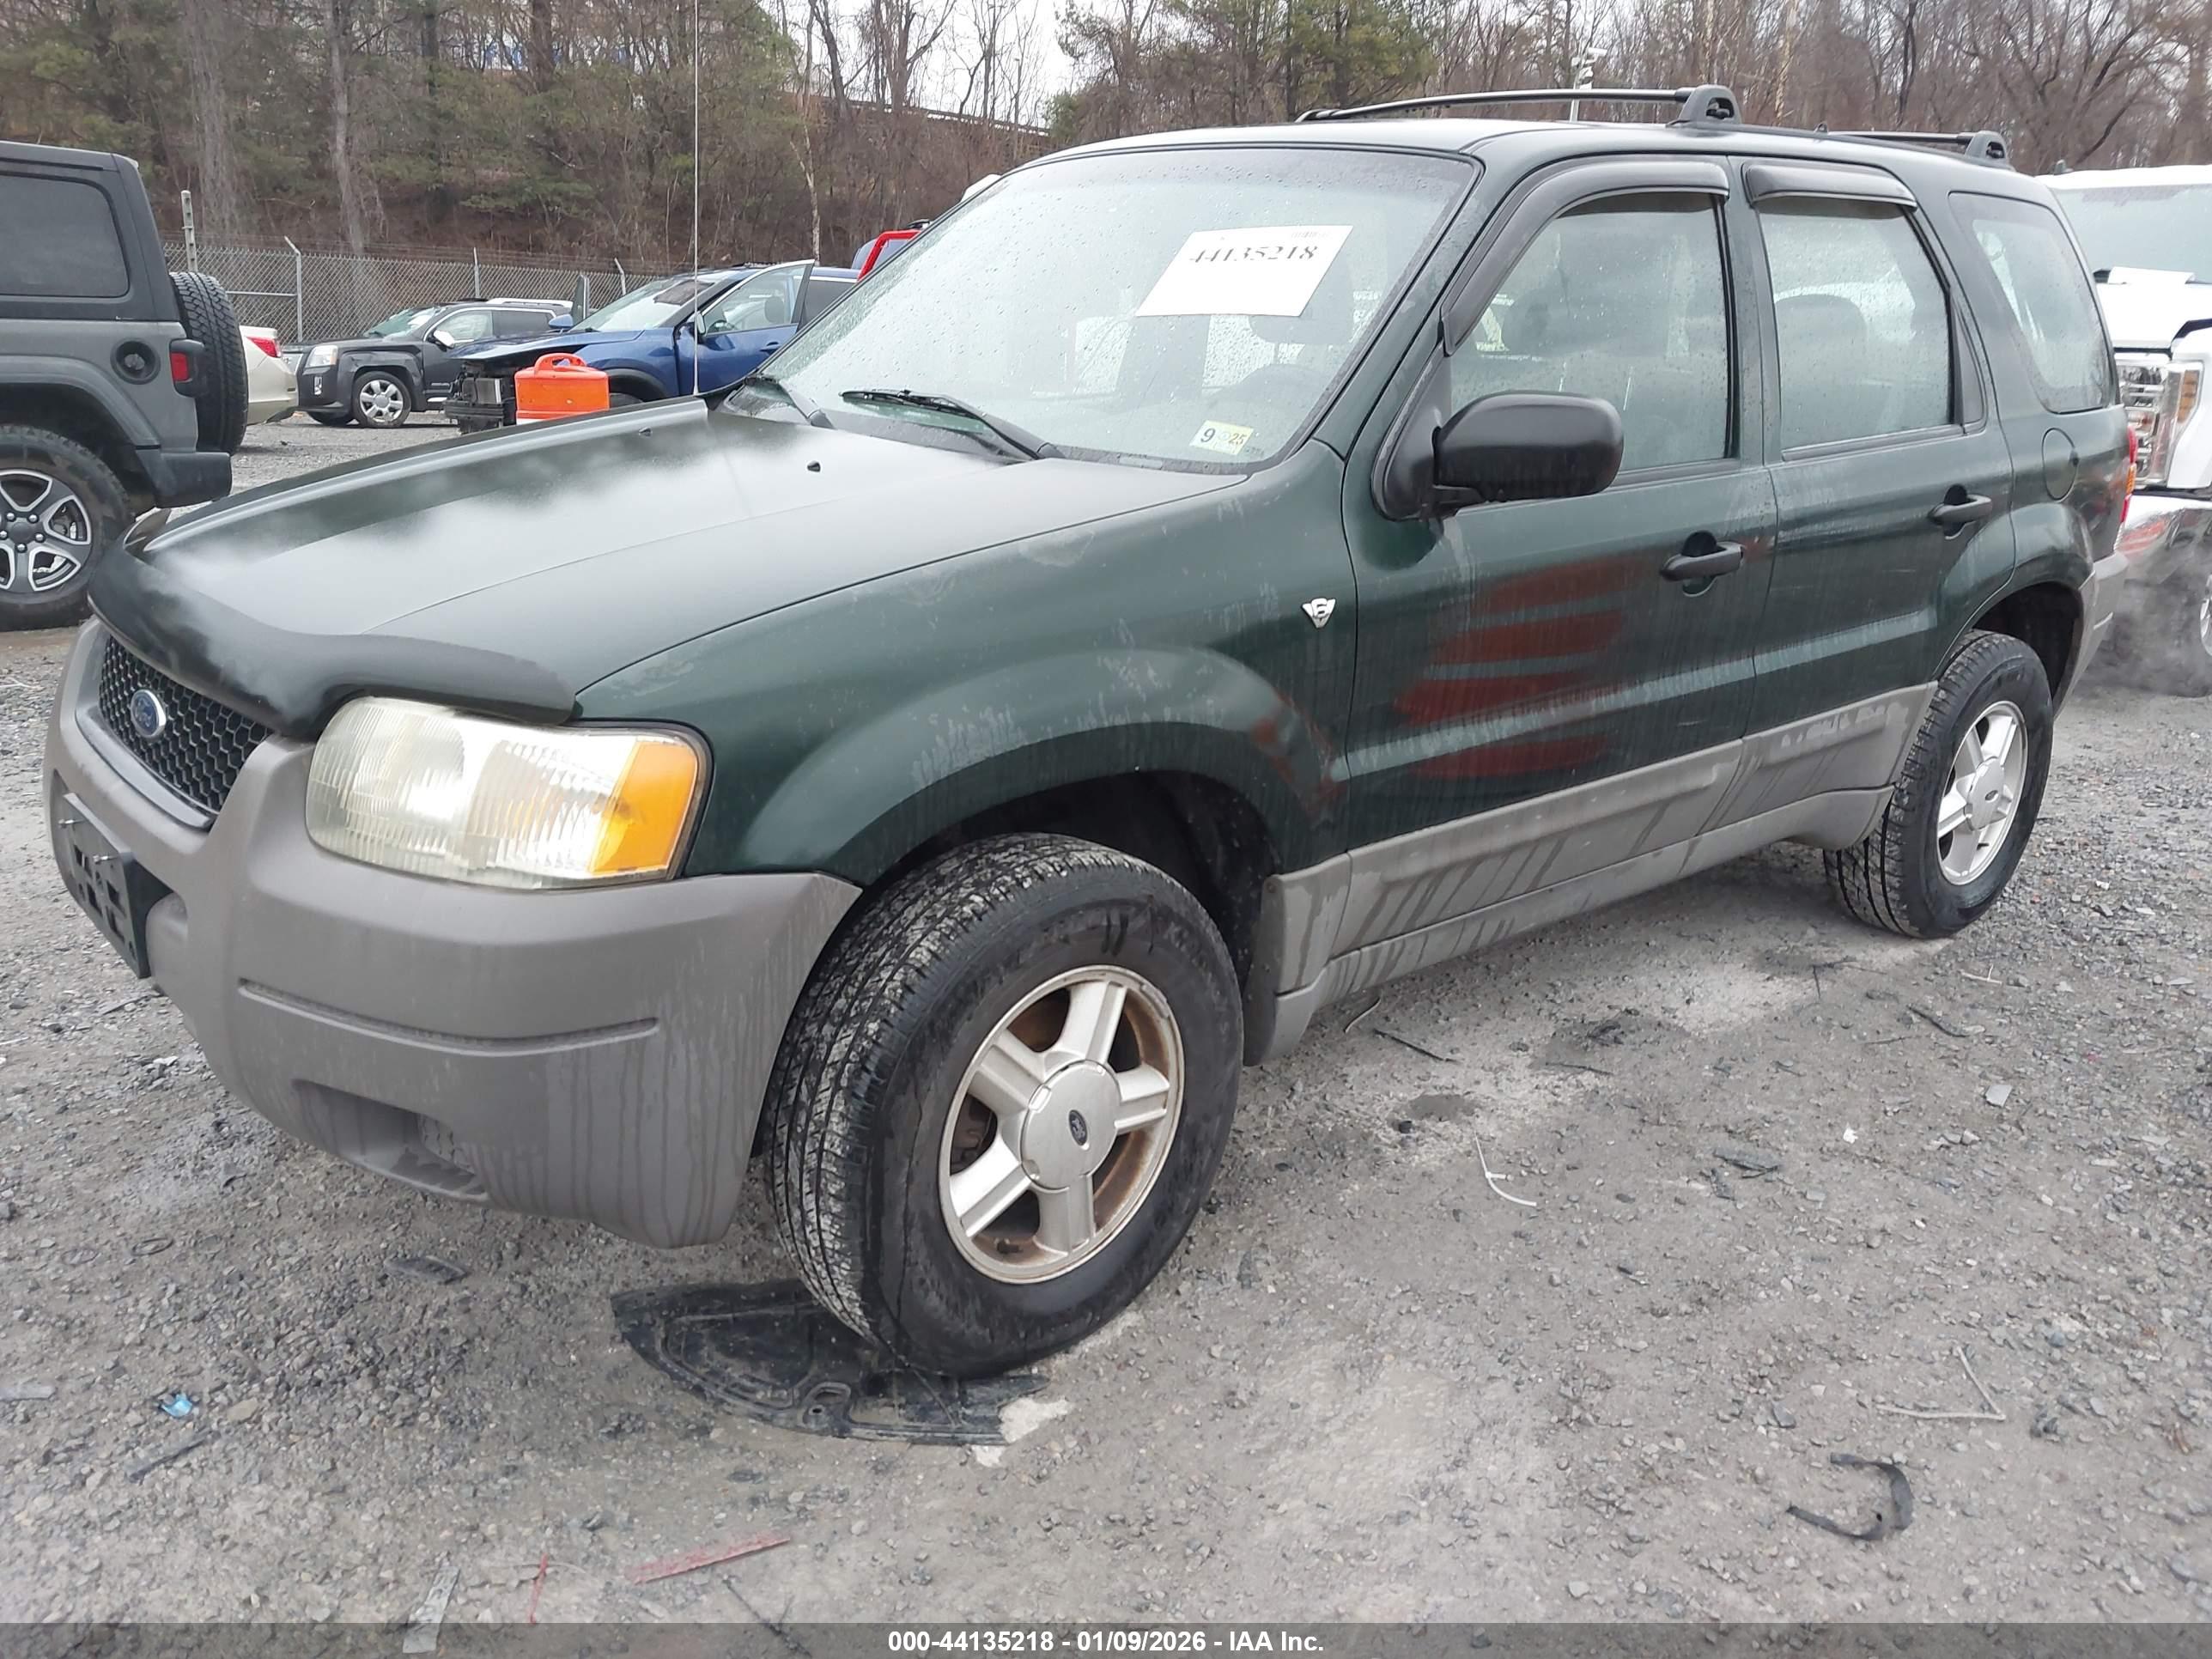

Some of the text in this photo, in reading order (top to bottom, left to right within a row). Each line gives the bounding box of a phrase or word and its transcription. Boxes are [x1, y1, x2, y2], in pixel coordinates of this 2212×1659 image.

[1189, 245, 1319, 264] 44135218
[1200, 428, 1248, 446] 9 25
